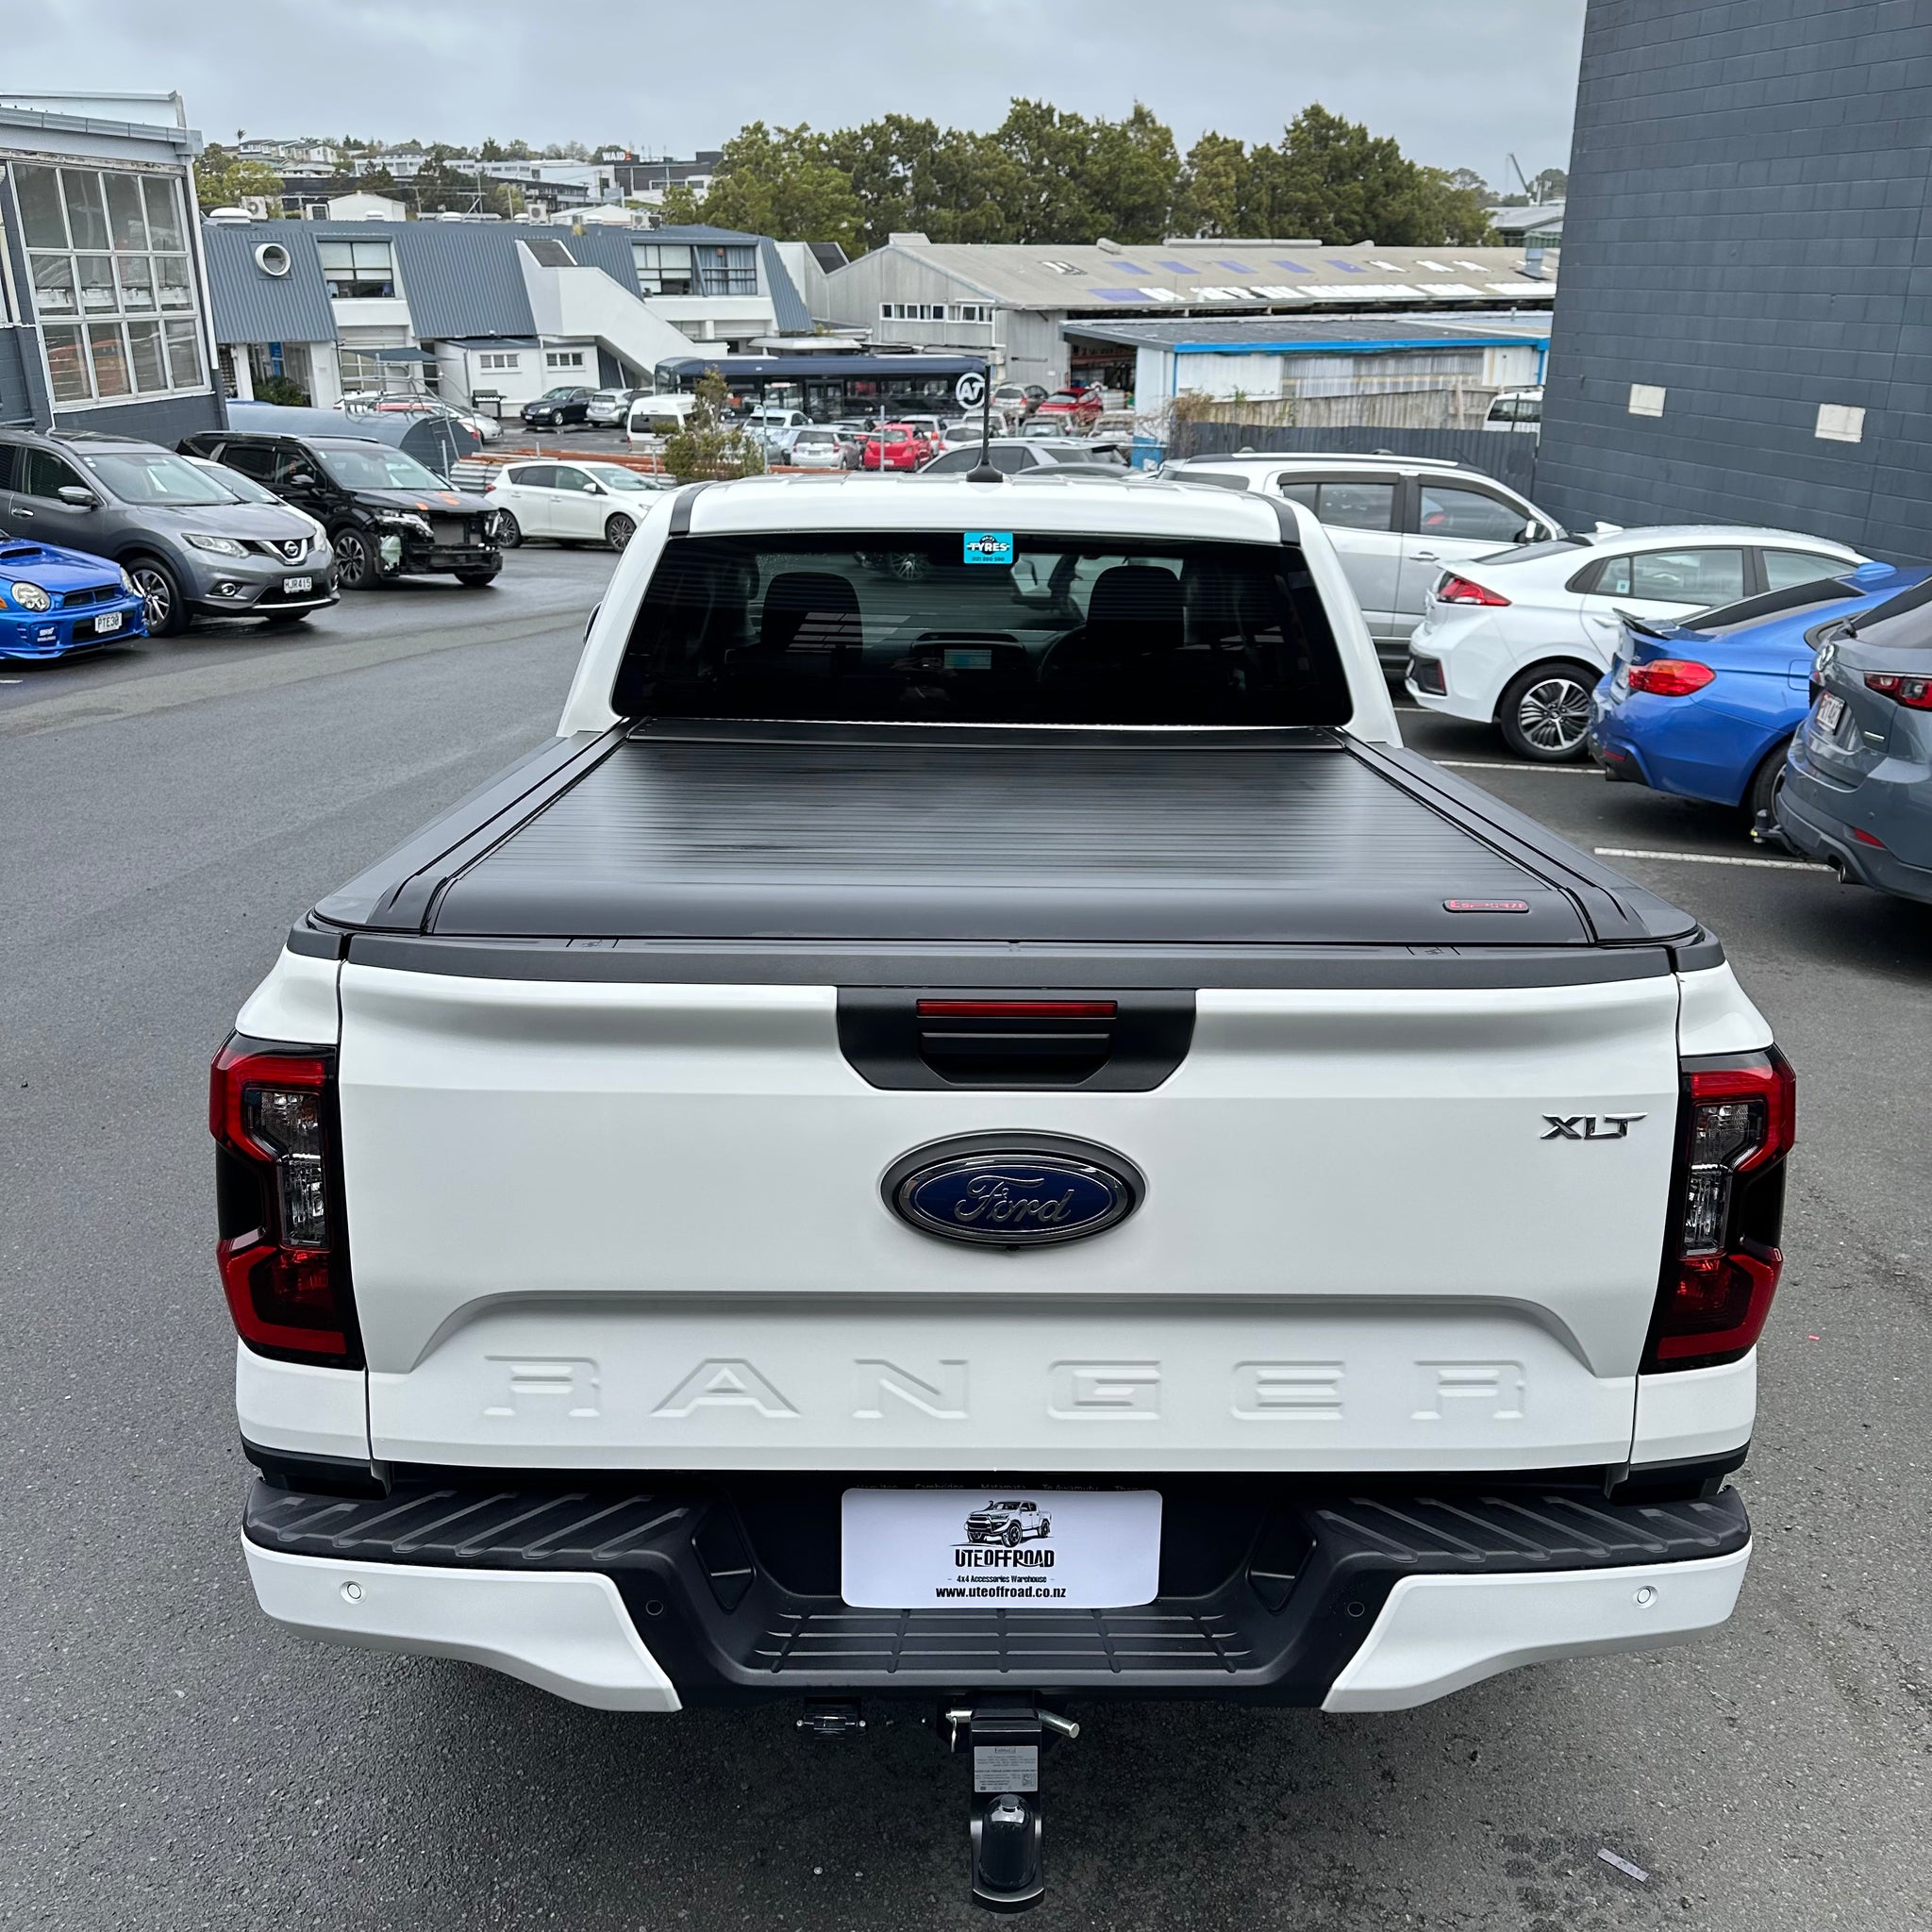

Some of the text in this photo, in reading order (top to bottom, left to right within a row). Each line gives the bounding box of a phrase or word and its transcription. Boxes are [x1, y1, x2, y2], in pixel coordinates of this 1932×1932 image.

[969, 542, 1008, 552] TYRES
[1541, 1112, 1648, 1140] XLT
[954, 1174, 1074, 1223] Ford
[484, 1355, 1526, 1419] RANGER
[956, 1549, 1055, 1567] UTEOFFROAD
[957, 1574, 1047, 1583] 4x4 Accessories Warehouse
[936, 1586, 1066, 1598] www.uteoffroad.co.nz
